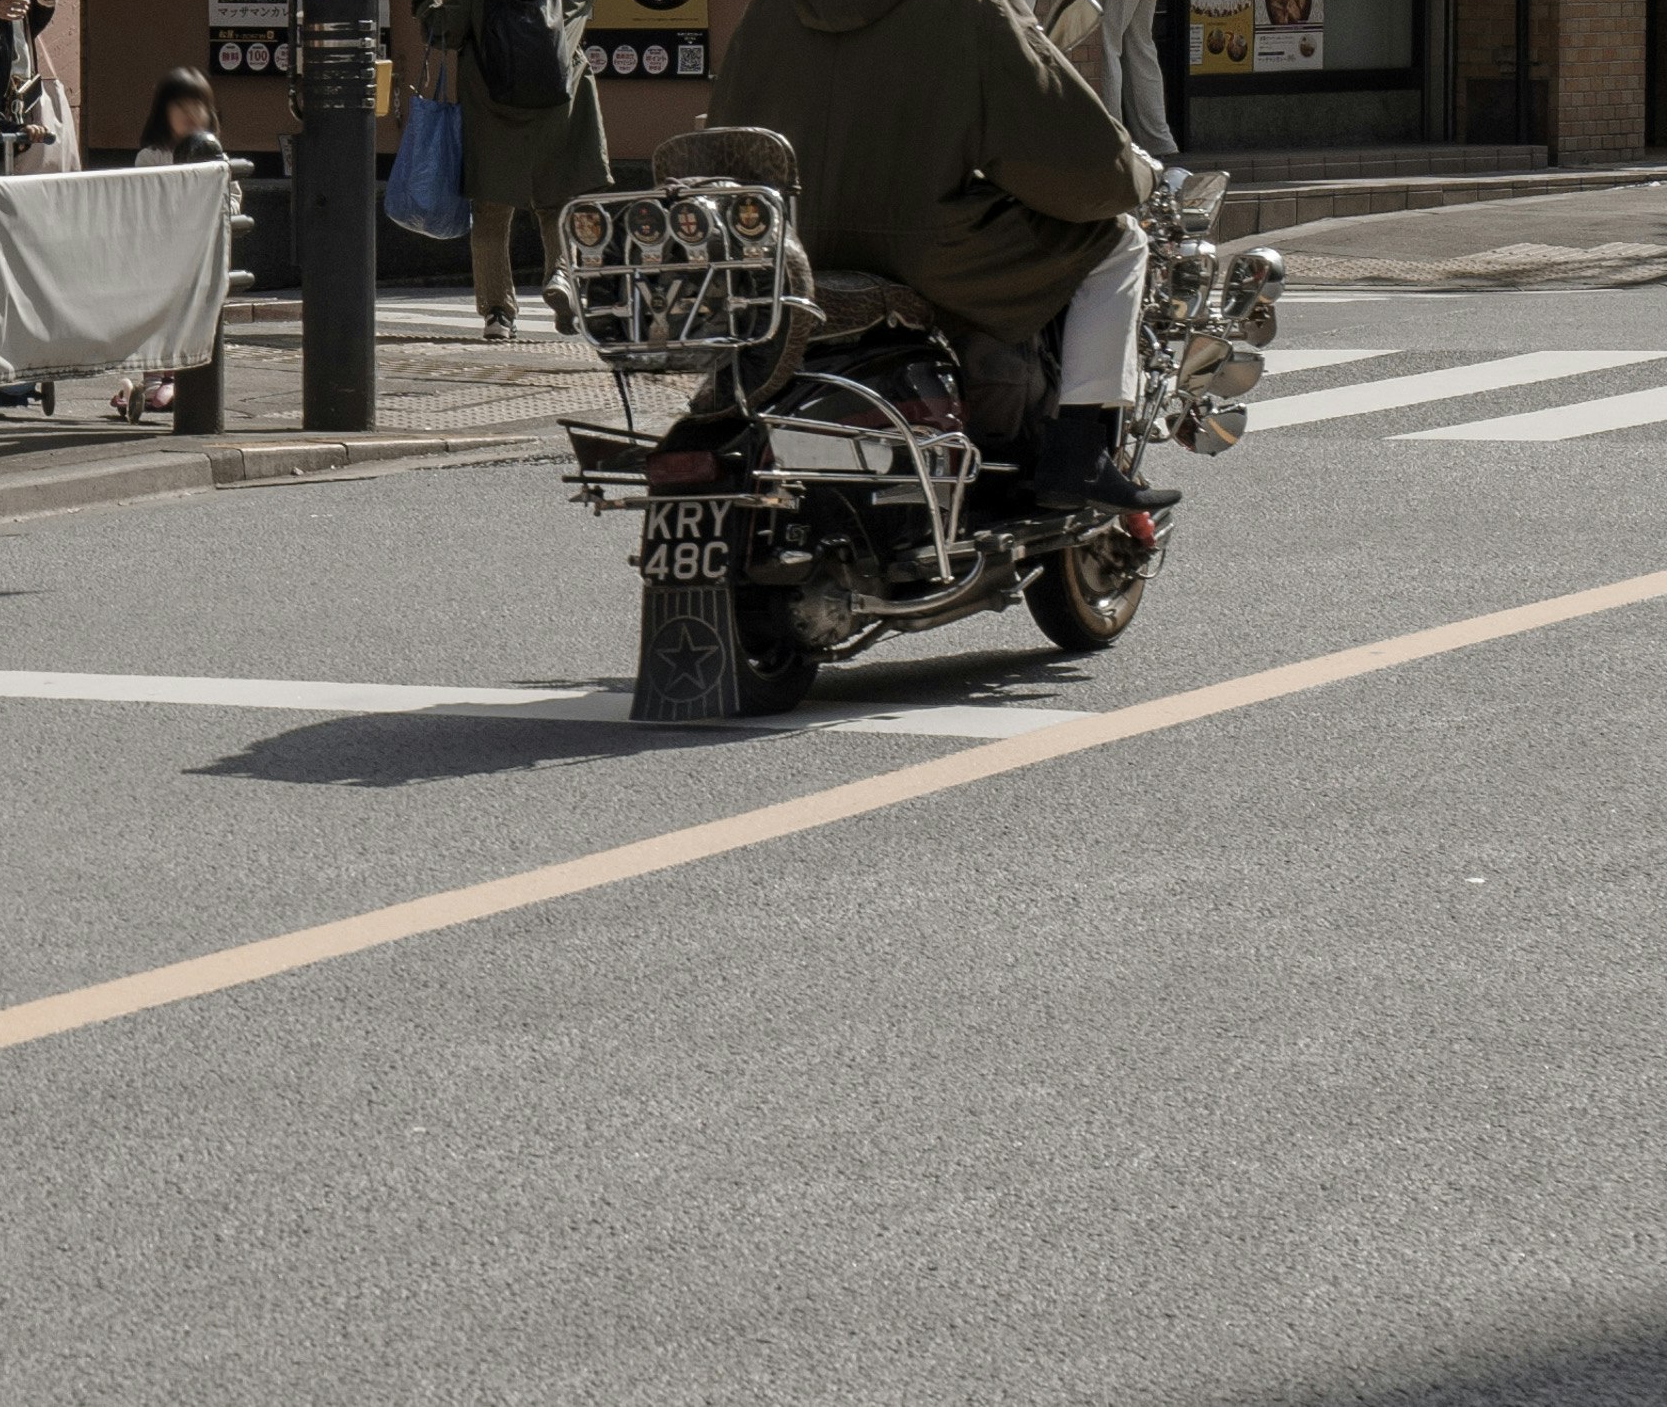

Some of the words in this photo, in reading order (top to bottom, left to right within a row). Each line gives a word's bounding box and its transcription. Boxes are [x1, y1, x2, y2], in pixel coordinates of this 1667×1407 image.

[249, 50, 268, 61] 100
[647, 499, 733, 540] KRY
[645, 541, 729, 580] 48C
